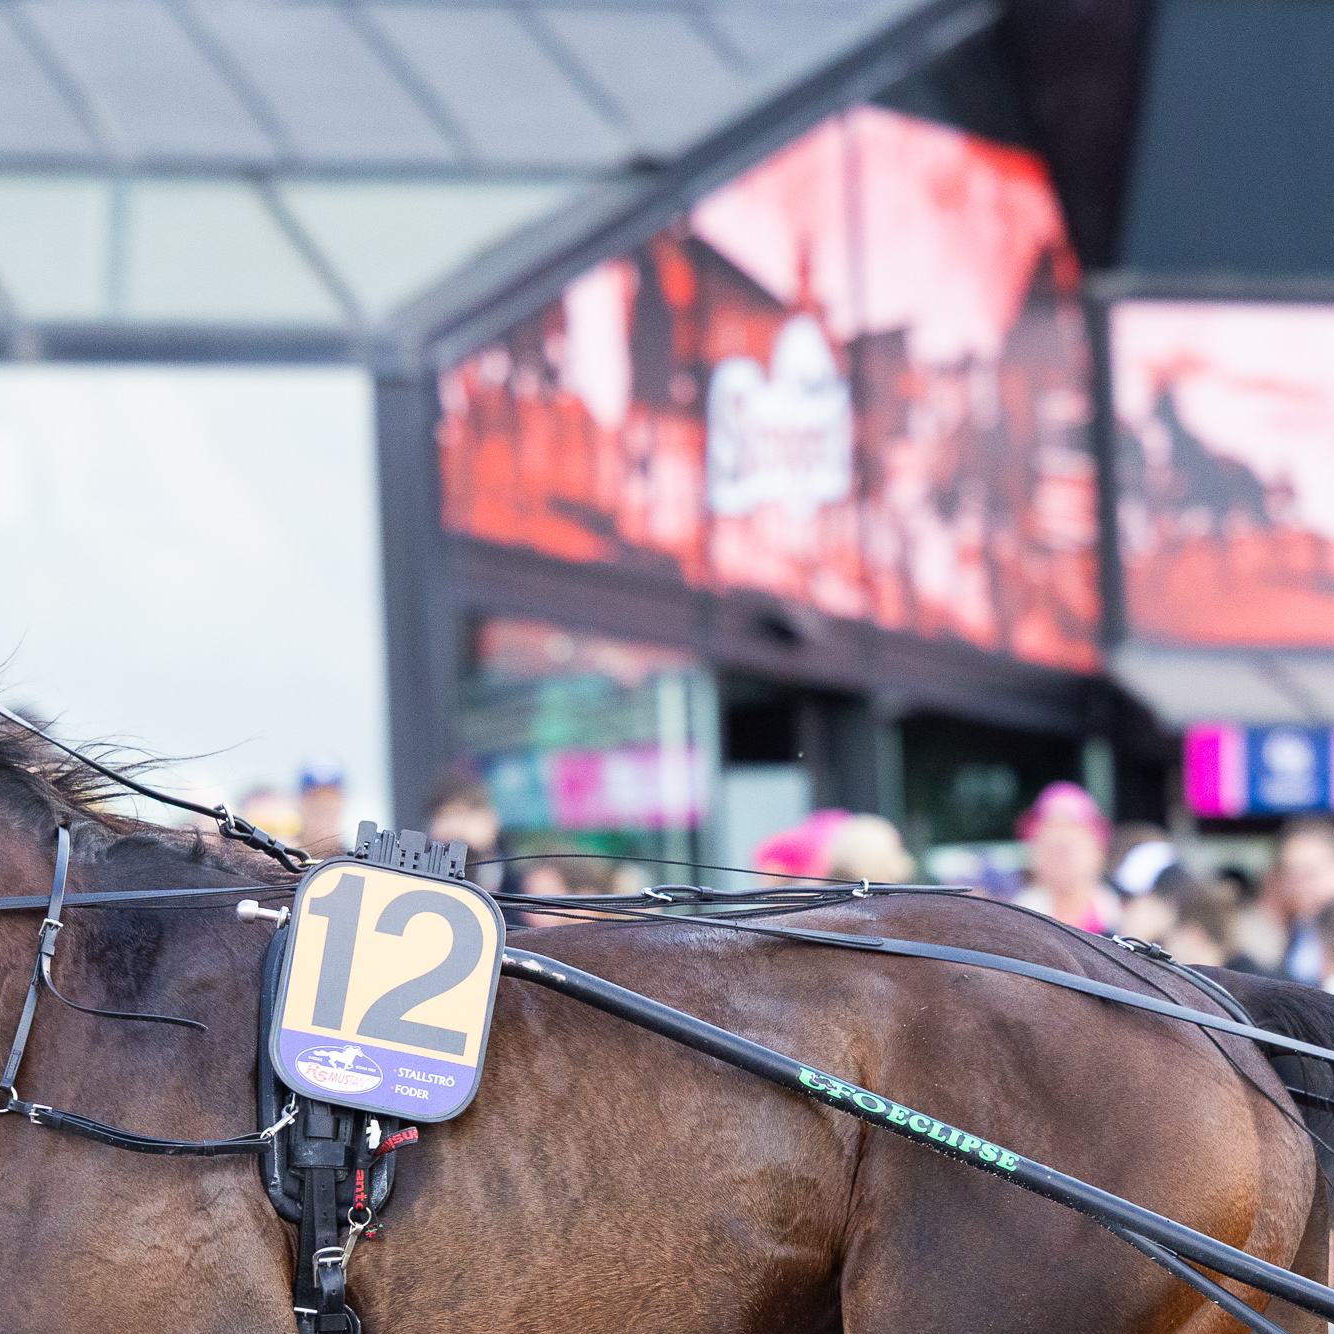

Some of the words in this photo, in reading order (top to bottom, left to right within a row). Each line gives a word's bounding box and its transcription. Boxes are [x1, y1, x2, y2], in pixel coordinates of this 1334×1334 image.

[308, 873, 484, 1057] 12
[394, 1084, 430, 1100] FODER
[397, 1067, 456, 1088] STALLSTRÖ
[798, 1066, 887, 1113] UFO
[886, 1104, 1021, 1172] ECLIPSE
